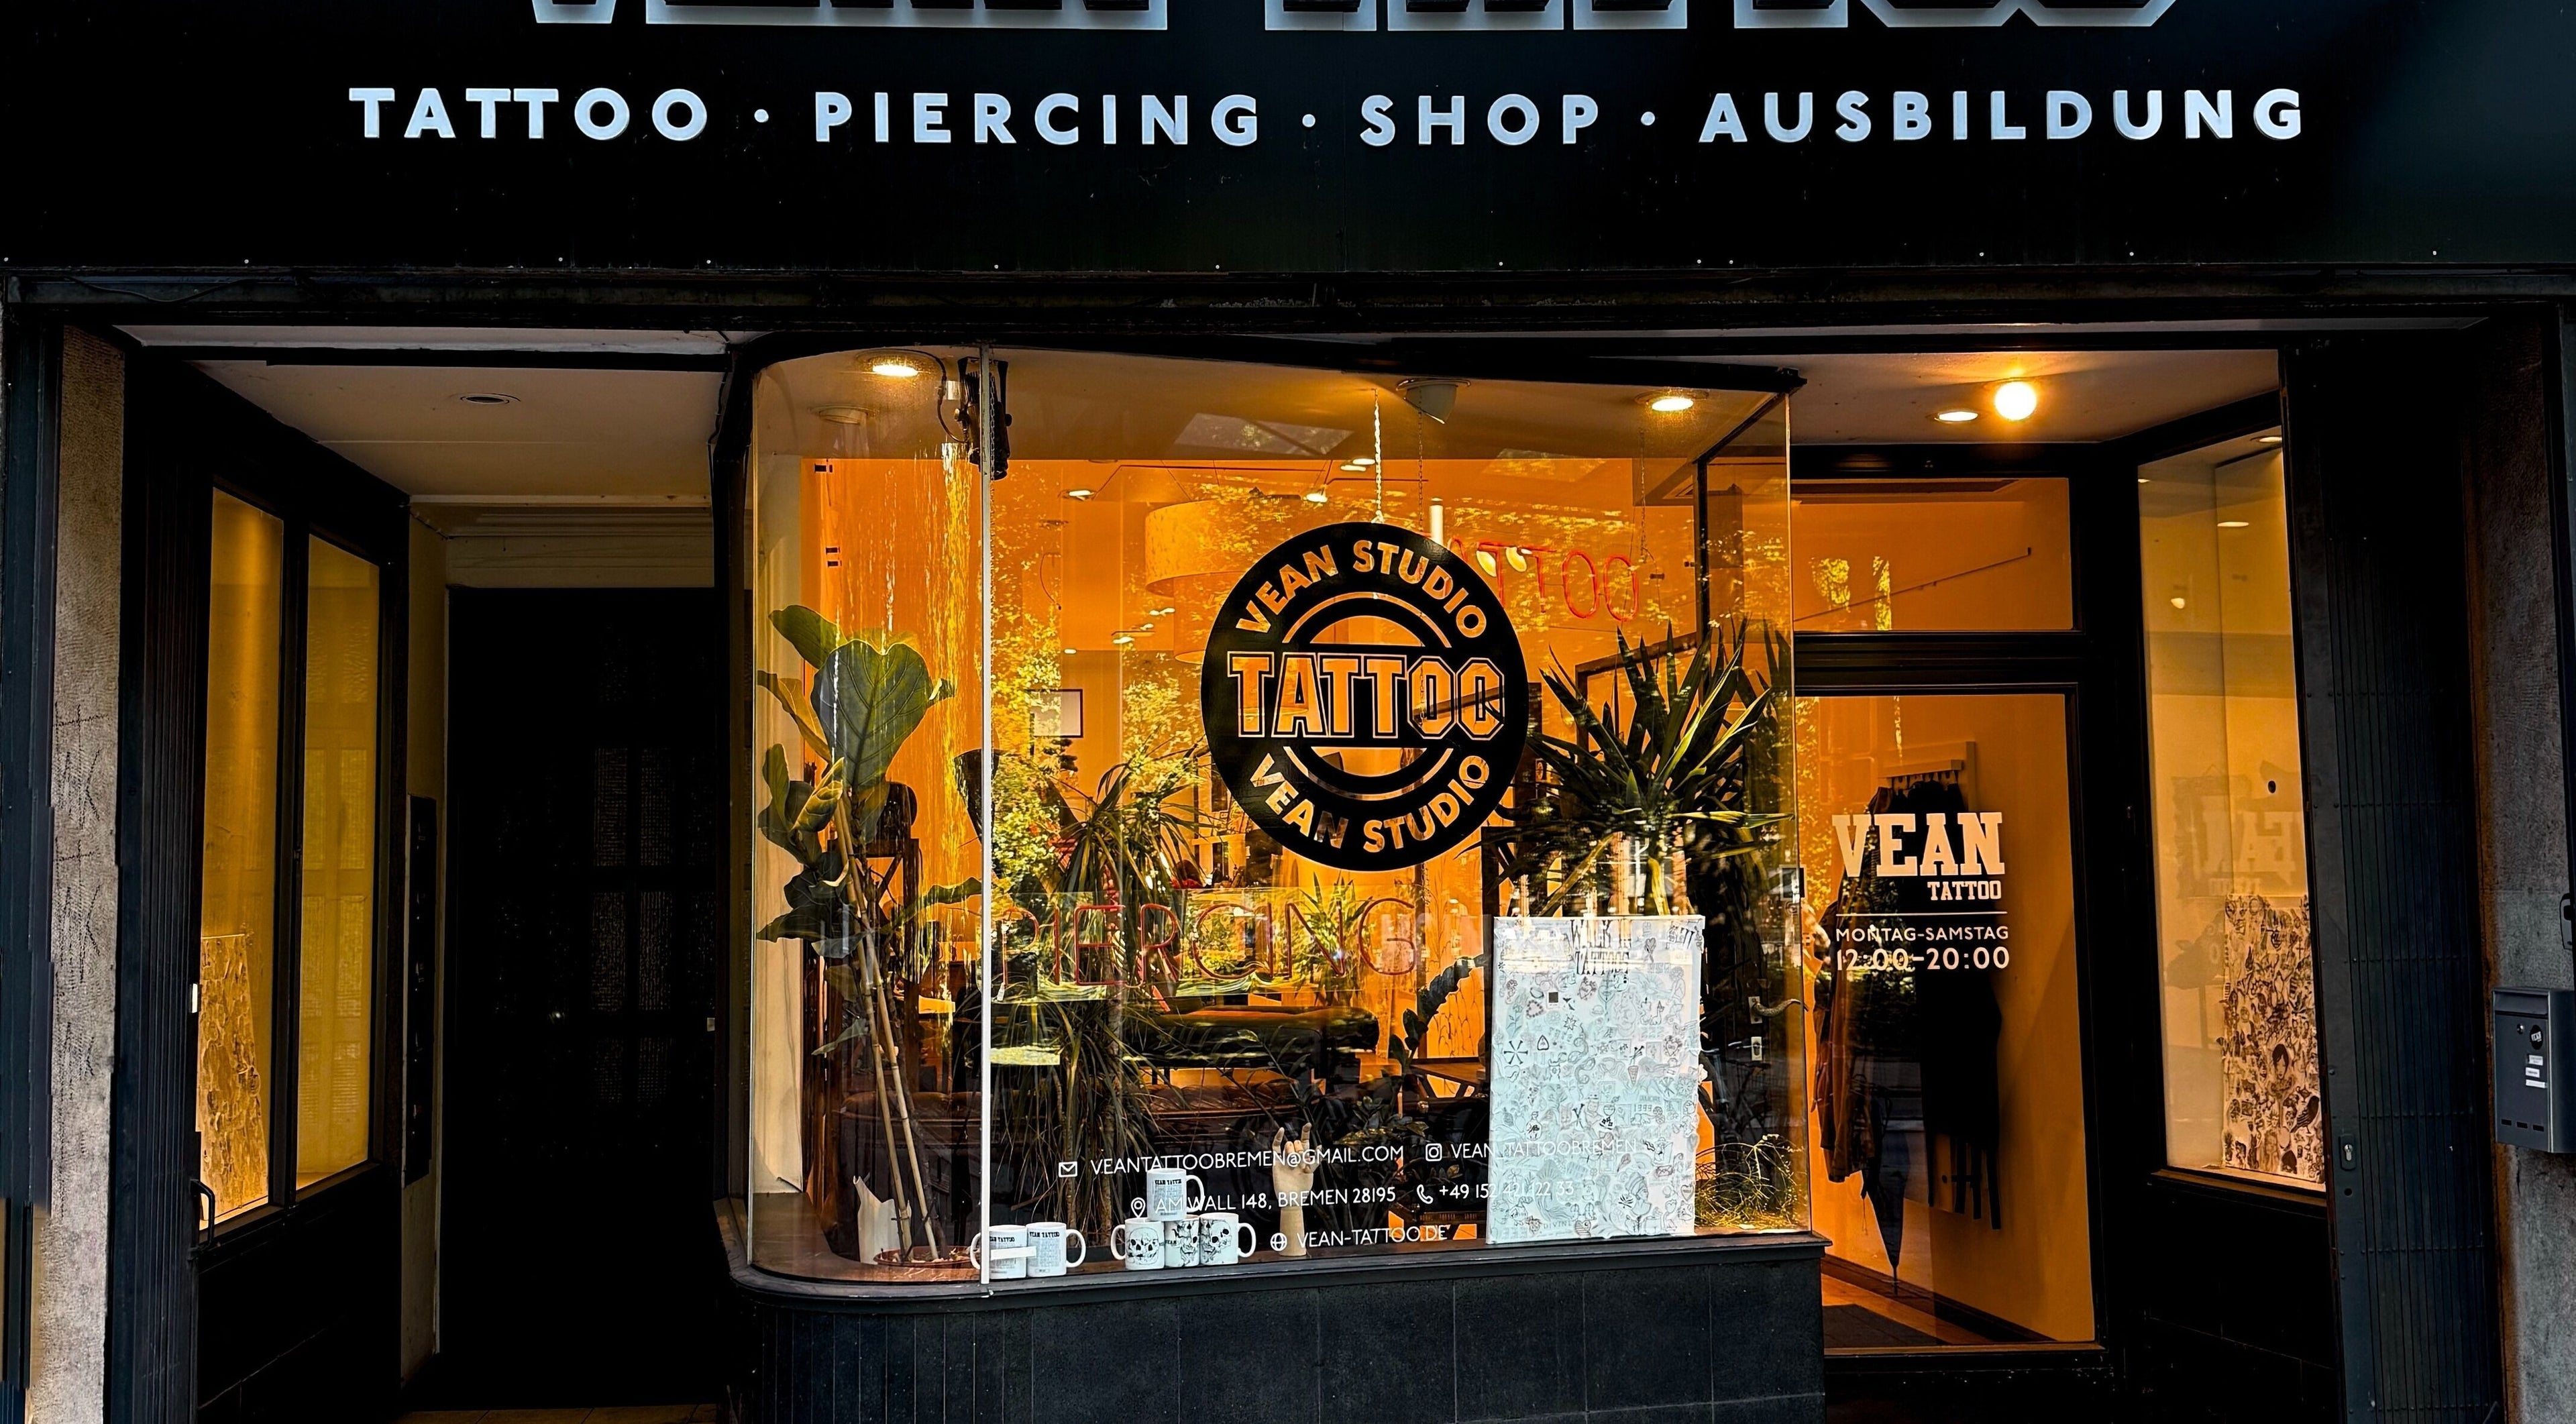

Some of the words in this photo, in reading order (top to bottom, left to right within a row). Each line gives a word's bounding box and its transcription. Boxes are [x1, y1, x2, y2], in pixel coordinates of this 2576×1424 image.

[350, 87, 708, 140] TATTOO
[815, 91, 1258, 147] PIERCING
[1359, 93, 1599, 147] SHOP
[1699, 88, 2303, 143] AUSBILDUNG
[1236, 545, 1339, 633] VEAN
[1352, 540, 1487, 638] STUDIO
[1227, 651, 1505, 741] TATTOO
[1250, 753, 1349, 850] VEAN
[1363, 755, 1490, 853] STUDIO
[1832, 812, 2005, 877] VEAN
[1927, 880, 2002, 901] TATTOO
[1001, 897, 1417, 987] PIERCING
[1835, 926, 2008, 942] MONTAG-SAMSTAG
[1836, 946, 2010, 971] 12:00-20:00
[1091, 1146, 1403, 1175] VEANTATTOOBREMEN@GMAIL.COM
[1155, 1197, 1183, 1213] AM
[1187, 1195, 1236, 1211] WALL
[1242, 1193, 1273, 1211] 148,
[1278, 1189, 1348, 1207] BREMEN
[1353, 1186, 1397, 1203] 28195
[1439, 1184, 1470, 1199] +49
[1476, 1183, 1497, 1199] 152
[1556, 1181, 1574, 1196] 33
